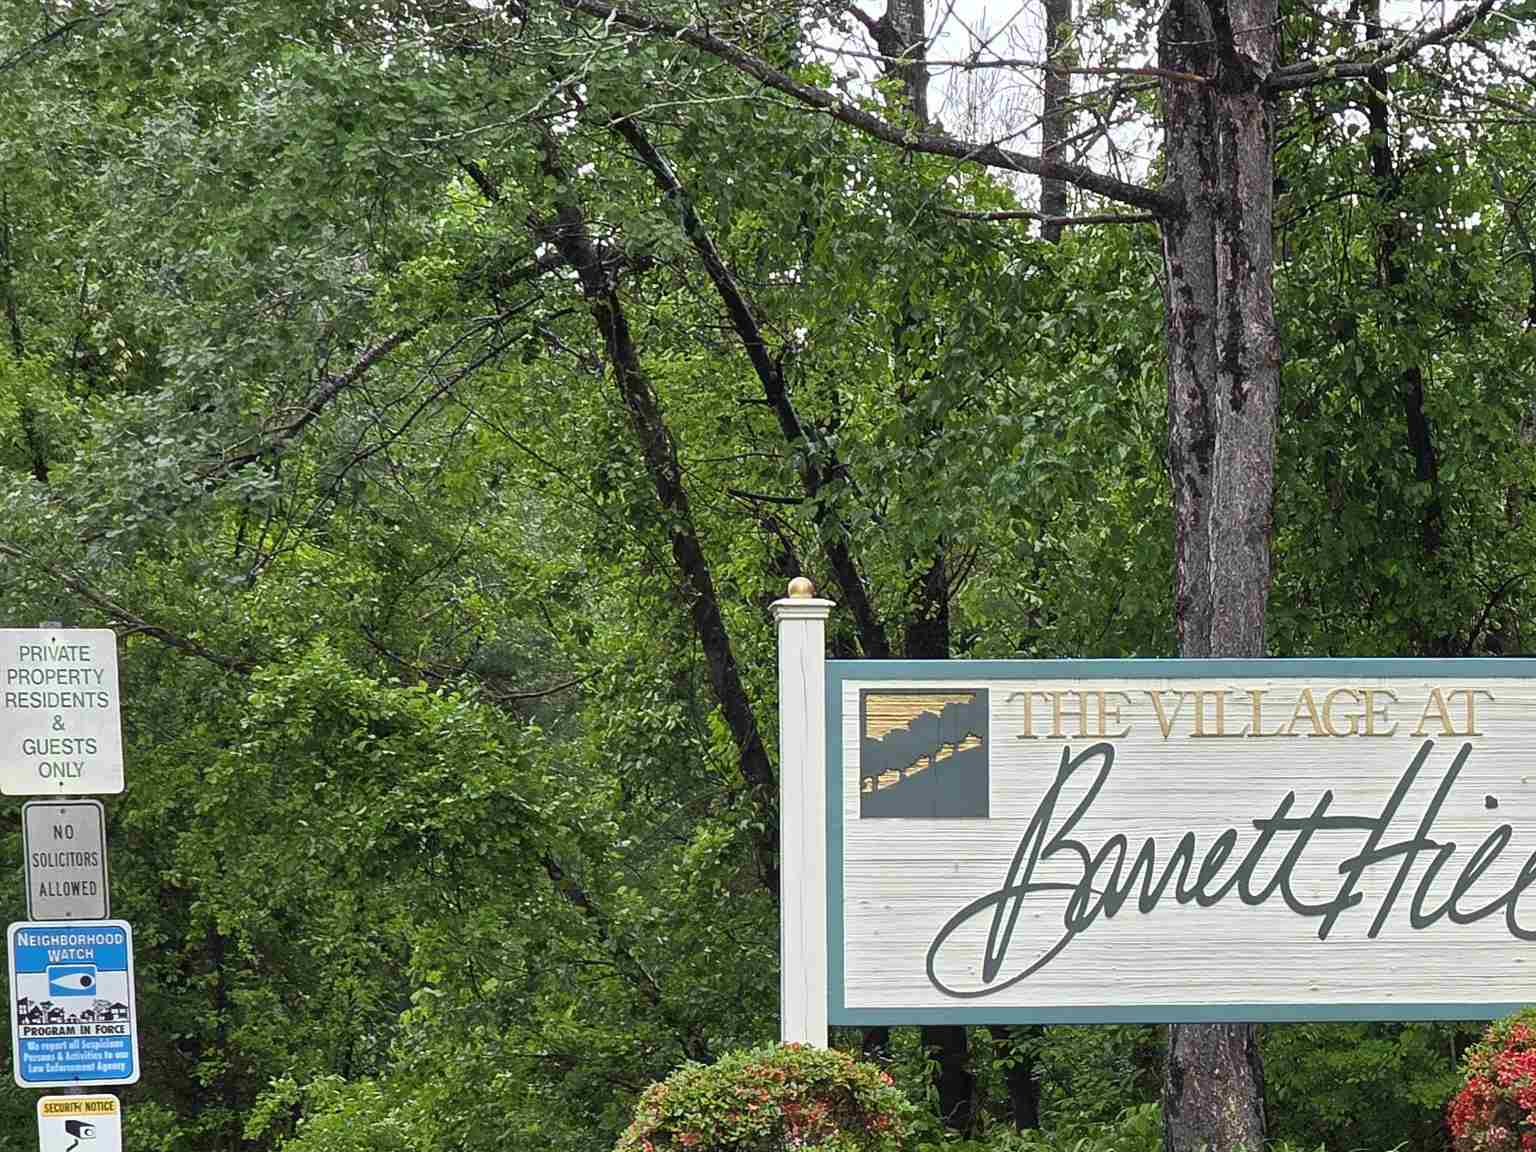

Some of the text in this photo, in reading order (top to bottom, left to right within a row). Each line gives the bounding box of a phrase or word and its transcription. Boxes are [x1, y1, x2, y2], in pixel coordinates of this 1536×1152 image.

[19, 645, 91, 662] PRIVATE
[7, 668, 105, 685] PROPERTY
[5, 691, 110, 709] RESIDENTS
[1007, 686, 1496, 741] THE VILLAGE AT
[51, 714, 66, 731] &
[22, 738, 97, 756] GUESTS
[38, 761, 85, 779] ONLY
[52, 824, 74, 840] NO
[32, 851, 98, 868] SOLICITORS
[925, 741, 1366, 1000] Barrett
[39, 880, 97, 897] ALLOWED
[17, 933, 124, 947] NEIGHBORHOOD
[47, 948, 95, 963] WATCH
[23, 1024, 126, 1036] PROGRAM IN FORCE
[43, 1101, 115, 1114] SECURITY NOTICE
